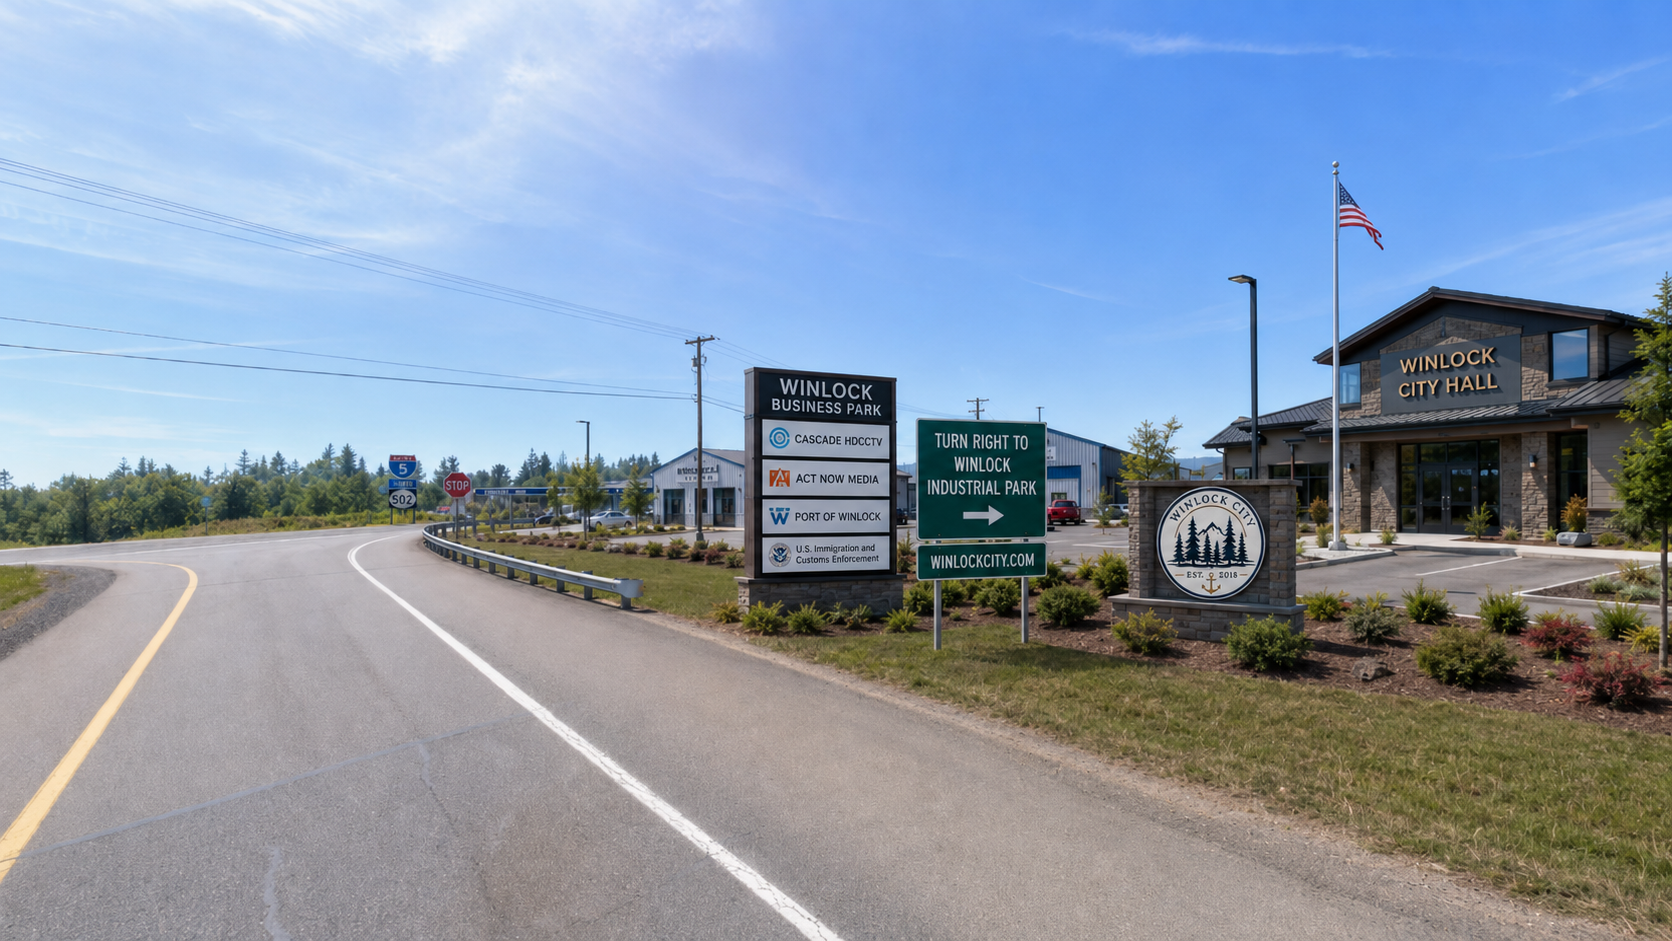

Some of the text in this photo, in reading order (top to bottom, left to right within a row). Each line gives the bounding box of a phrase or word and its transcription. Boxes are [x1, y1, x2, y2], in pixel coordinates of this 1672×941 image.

[1400, 347, 1495, 373] WINLOCK
[779, 378, 873, 400] WINLOCK
[1399, 373, 1498, 398] CITY HALL
[771, 398, 882, 416] BUSINESS PARK
[795, 434, 883, 446] CASCADE HDCCTV
[934, 432, 1028, 450] TURN RIGHT TO
[398, 463, 408, 475] 5
[954, 456, 1011, 473] WINLOCK
[445, 480, 469, 491] STOP
[795, 474, 879, 484] ACT NOW MEDIA
[927, 479, 1037, 495] INDUSTRIAL PARK
[392, 494, 413, 505] 502
[795, 512, 881, 521] PORT OF WINLOCK
[1169, 494, 1256, 526] WINLOCK CITY
[796, 544, 875, 554] U.S. Immigration and
[796, 555, 879, 564] Customs Enforcement
[930, 553, 1035, 569] WINLOCKCITY.COM
[1218, 571, 1238, 579] 2018
